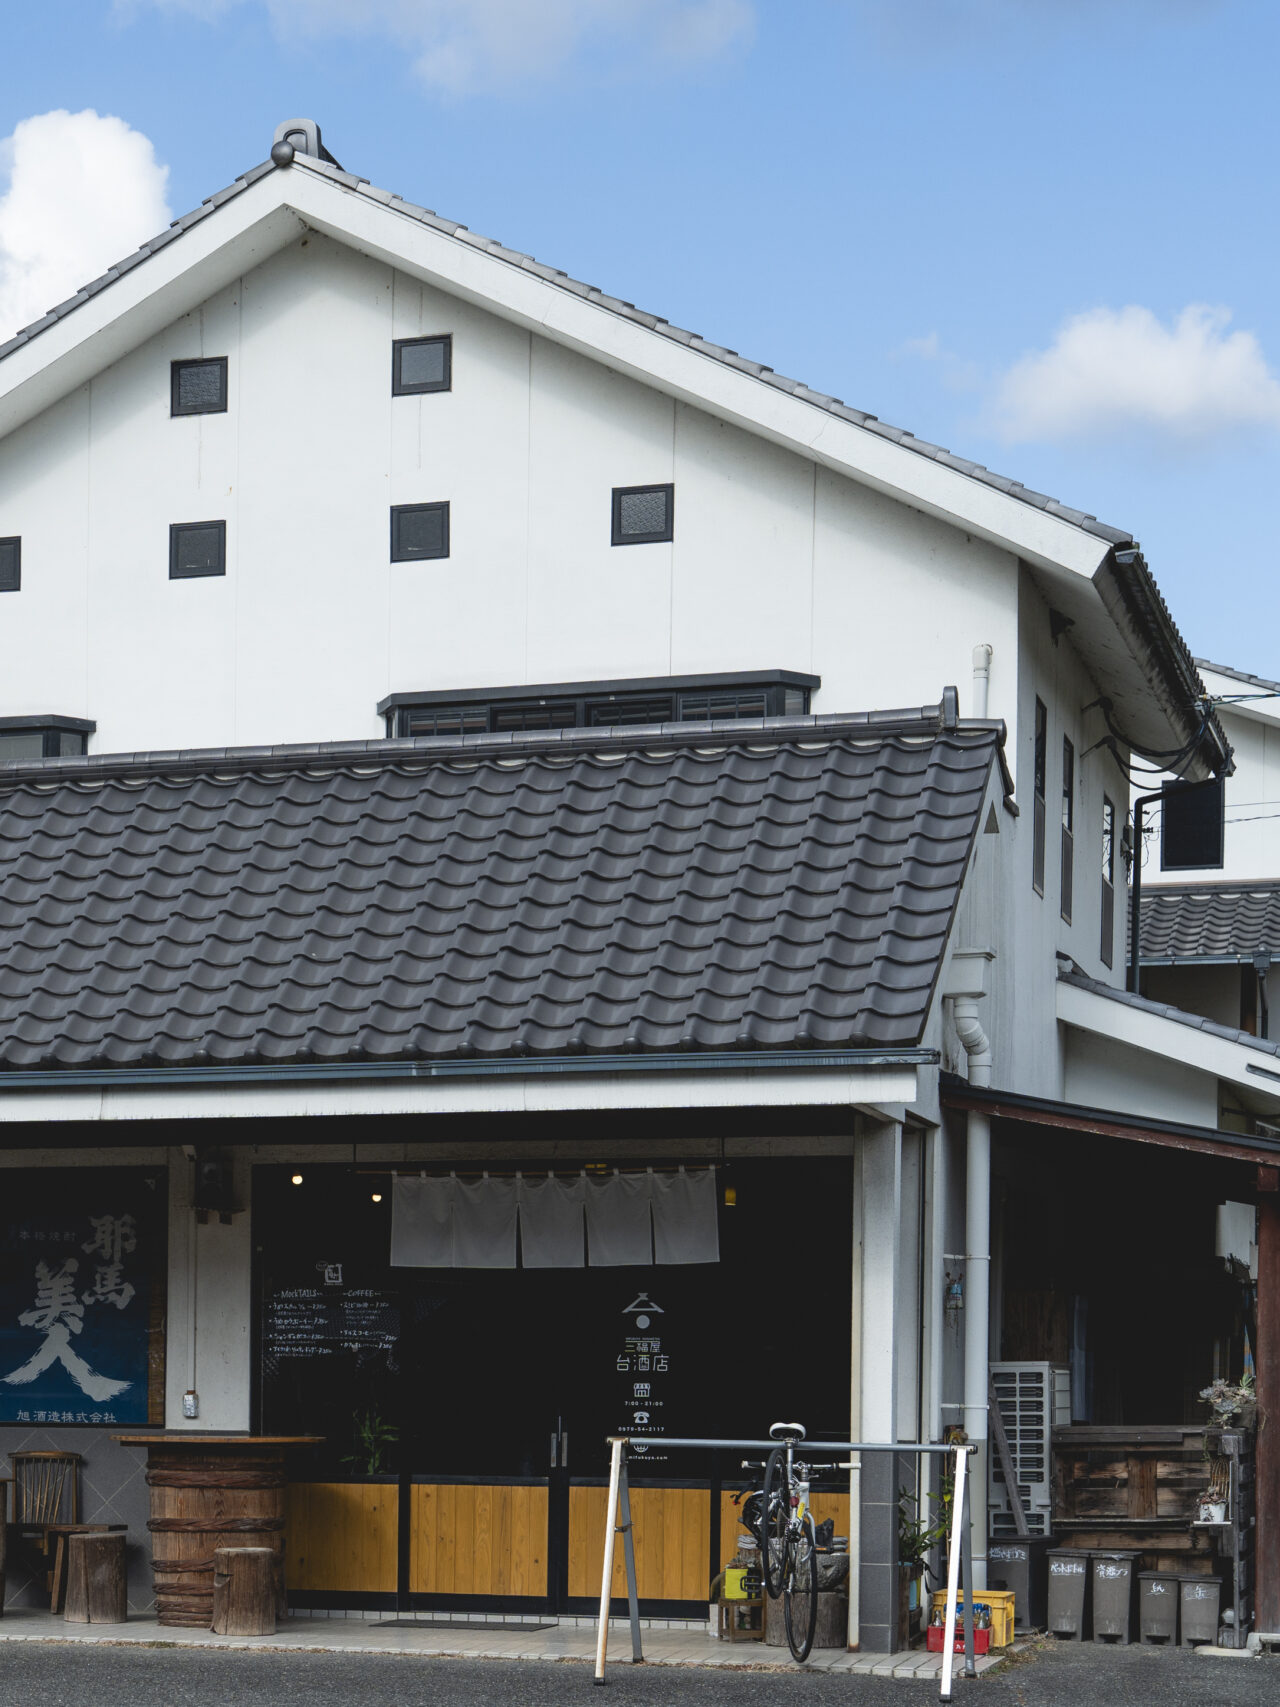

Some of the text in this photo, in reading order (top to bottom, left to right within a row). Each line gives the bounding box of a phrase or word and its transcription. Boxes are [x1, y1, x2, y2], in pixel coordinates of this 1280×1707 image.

[81, 1212, 137, 1310] 耶馬
[624, 1340, 661, 1353] 三福屋
[616, 1354, 670, 1372] 台酒店
[16, 1409, 118, 1423] 旭酒造株式会社
[1095, 1564, 1129, 1578] 資源プラ
[1194, 1585, 1207, 1599] 缶
